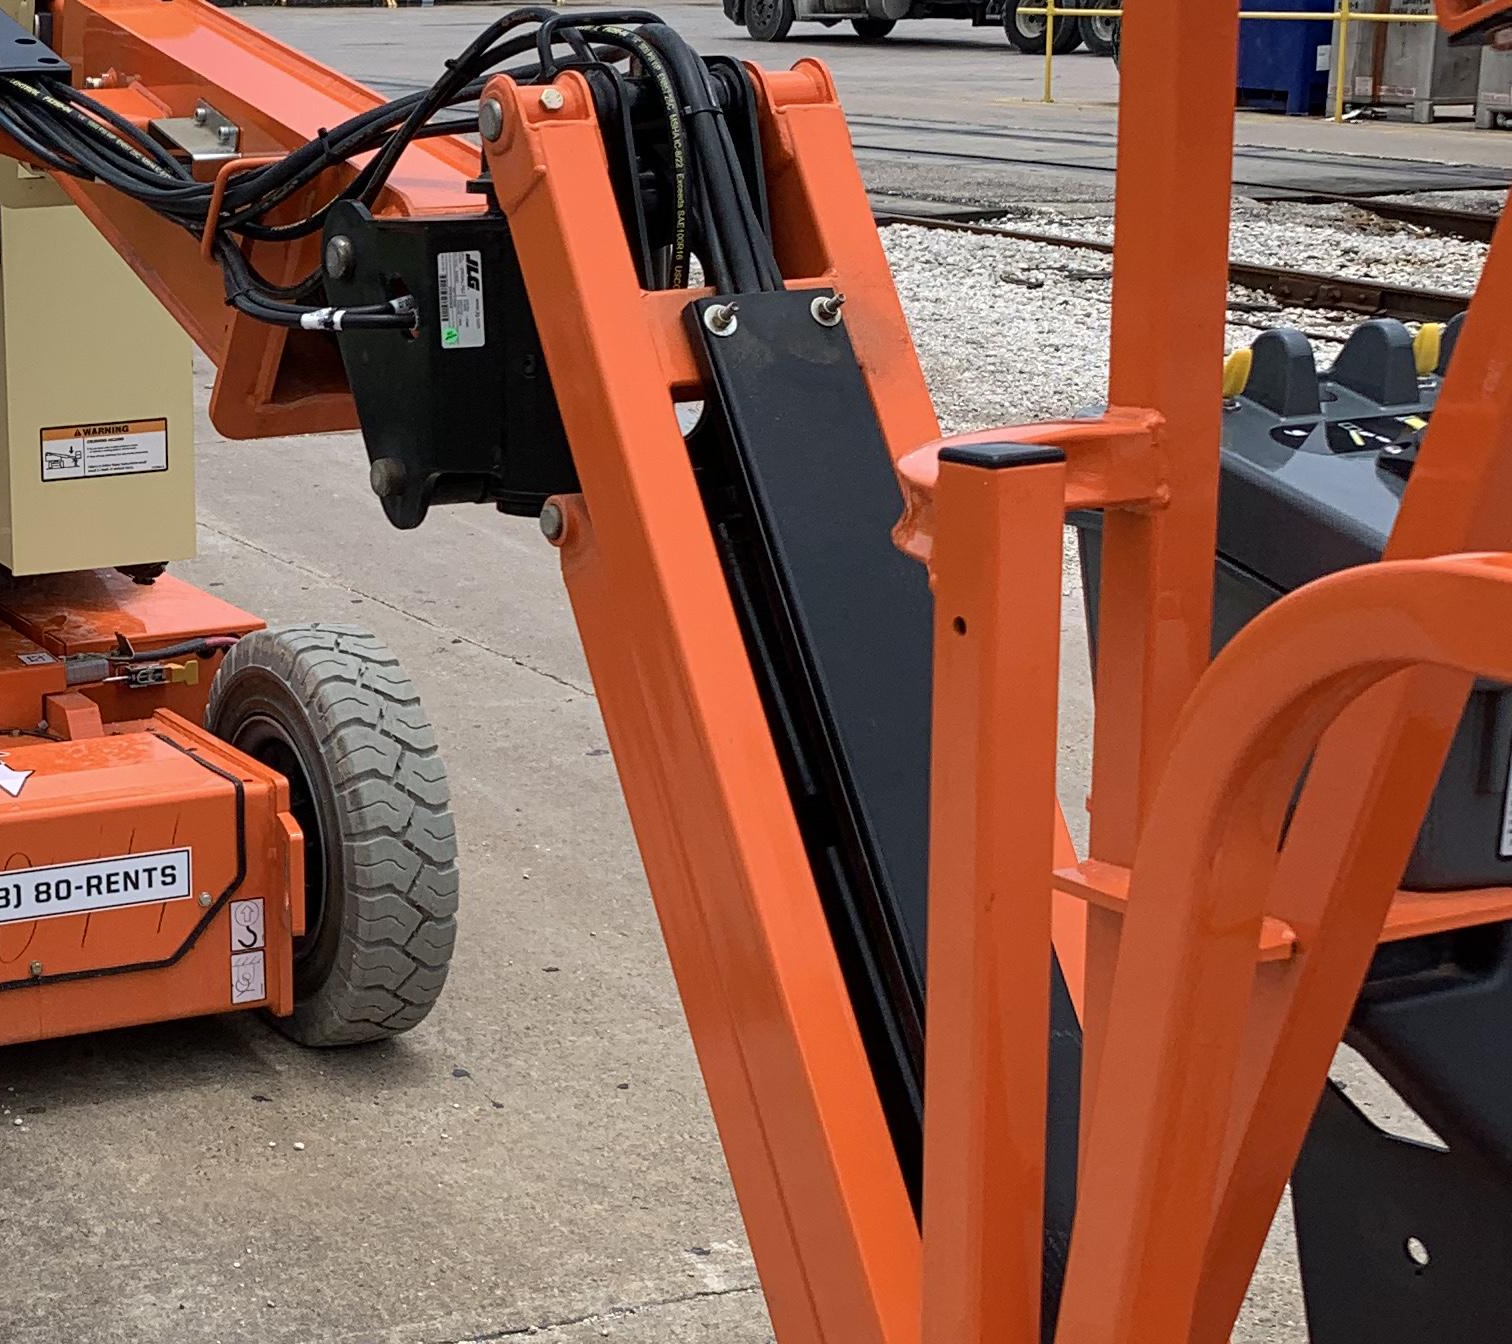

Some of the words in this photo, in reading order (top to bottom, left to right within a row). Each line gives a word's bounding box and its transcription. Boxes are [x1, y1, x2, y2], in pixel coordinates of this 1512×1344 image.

[465, 253, 480, 292] JLG
[82, 425, 130, 436] WARNING
[34, 865, 178, 903] 80-RENTS
